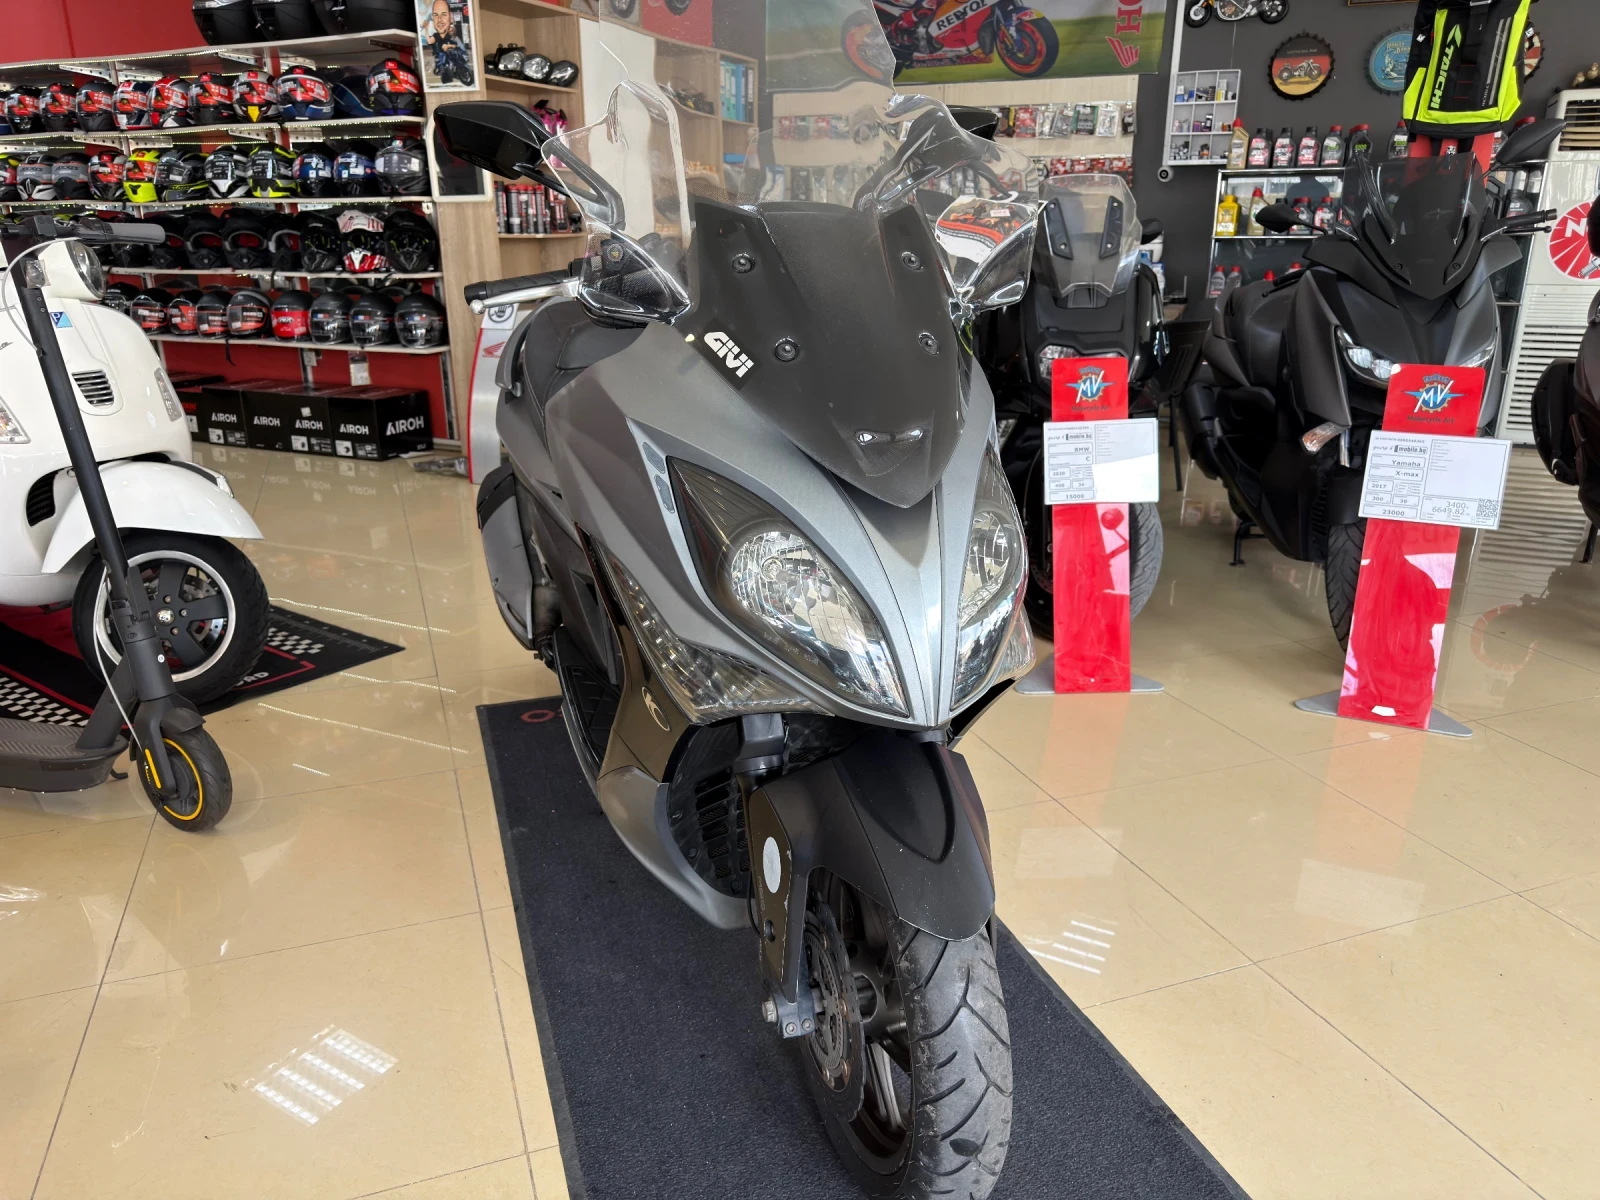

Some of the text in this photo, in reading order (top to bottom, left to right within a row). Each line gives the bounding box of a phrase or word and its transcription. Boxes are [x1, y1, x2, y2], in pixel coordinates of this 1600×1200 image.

[1116, 0, 1143, 35] H
[1430, 44, 1454, 109] TAICHI
[703, 331, 755, 378] GIVI
[1075, 370, 1105, 404] MV
[1413, 380, 1455, 413] MV
[211, 412, 237, 423] AIROH
[253, 416, 281, 427] AIROH
[295, 419, 323, 430] AIROH
[339, 423, 369, 435] AIROH
[386, 415, 425, 436] AIROH
[1399, 446, 1427, 454] mobile.bg
[1392, 459, 1421, 467] Yamaha
[1432, 506, 1465, 515] 6649.82
[1446, 501, 1466, 509] 3400
